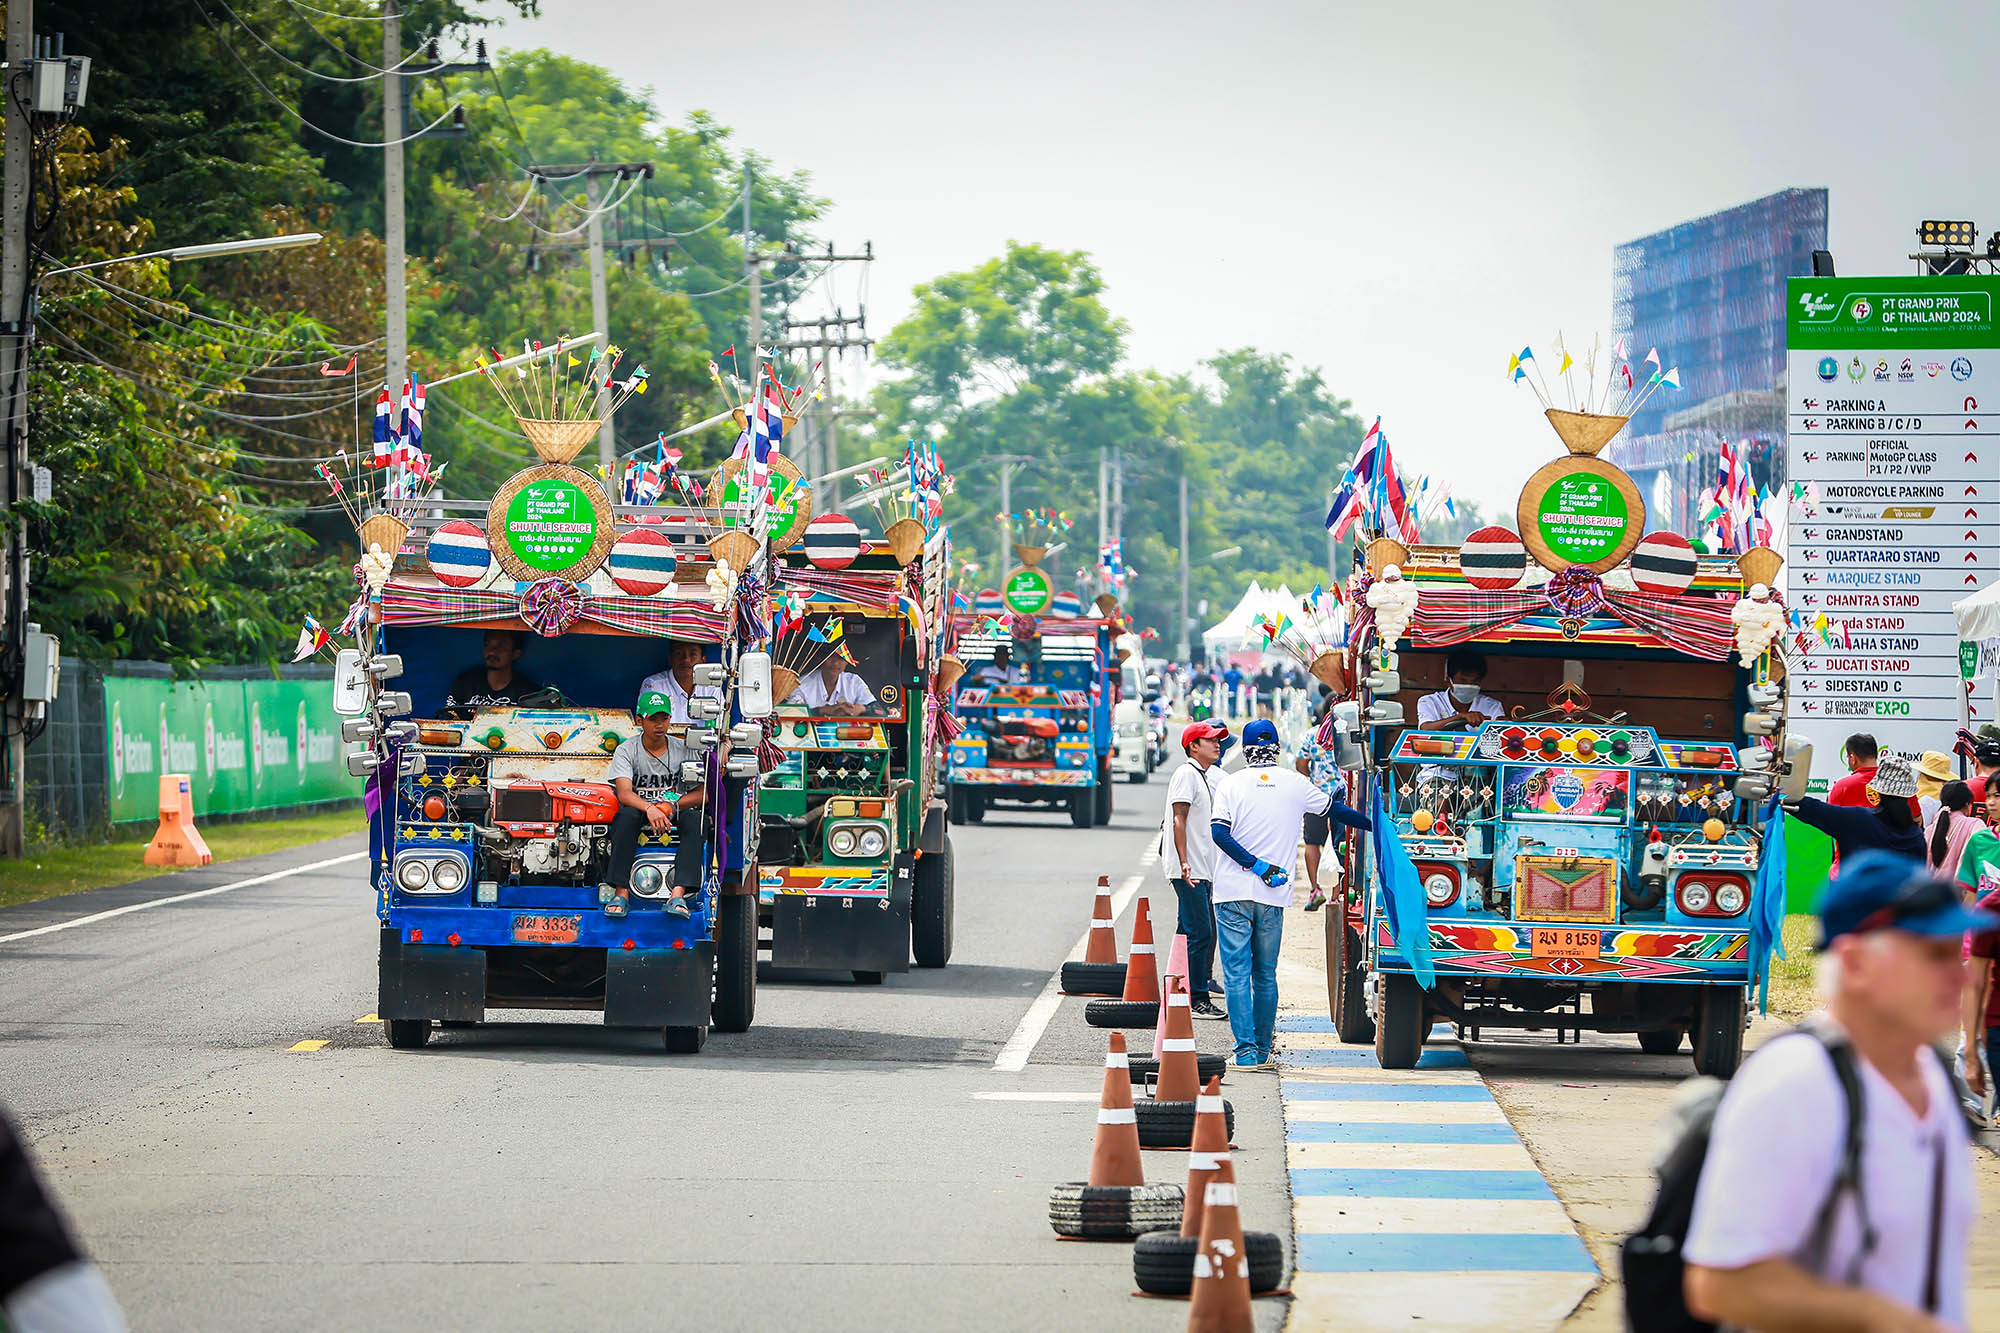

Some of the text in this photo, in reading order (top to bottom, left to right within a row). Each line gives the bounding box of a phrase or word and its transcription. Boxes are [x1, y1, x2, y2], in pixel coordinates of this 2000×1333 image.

[1882, 297, 1960, 309] PT GRAND PRIX
[1882, 311, 1981, 323] OF THAILAND 2024
[1826, 400, 1886, 411] PARKING A
[1826, 418, 1922, 430] PARKING B / C / D
[1870, 440, 1909, 450] OFFICIAL
[1826, 452, 1865, 462] PARKING
[1870, 452, 1937, 462] MotoGP CLASS
[1870, 465, 1931, 474] P1 / P2 / VVIP
[1826, 486, 1944, 498] MOTORCYCLE PARKING
[1543, 514, 1623, 527] SHUTTLE SERVICE
[510, 522, 591, 533] SHUTTLE SERVICE
[1826, 529, 1903, 541] GRANDSTAND
[1826, 551, 1940, 564] QUARTARARO STAND
[1826, 573, 1920, 586] MARQUEZ STAND
[1826, 595, 1920, 607] CHANTRA STAND
[1826, 617, 1904, 630] Hnda STAND
[1880, 638, 1918, 650] STAND
[1826, 660, 1910, 672] DUCATI STAND
[1826, 680, 1902, 692] SIDESTAND C
[1876, 702, 1910, 715] EXPO
[1808, 779, 1827, 788] hang
[1566, 932, 1597, 946] 8159
